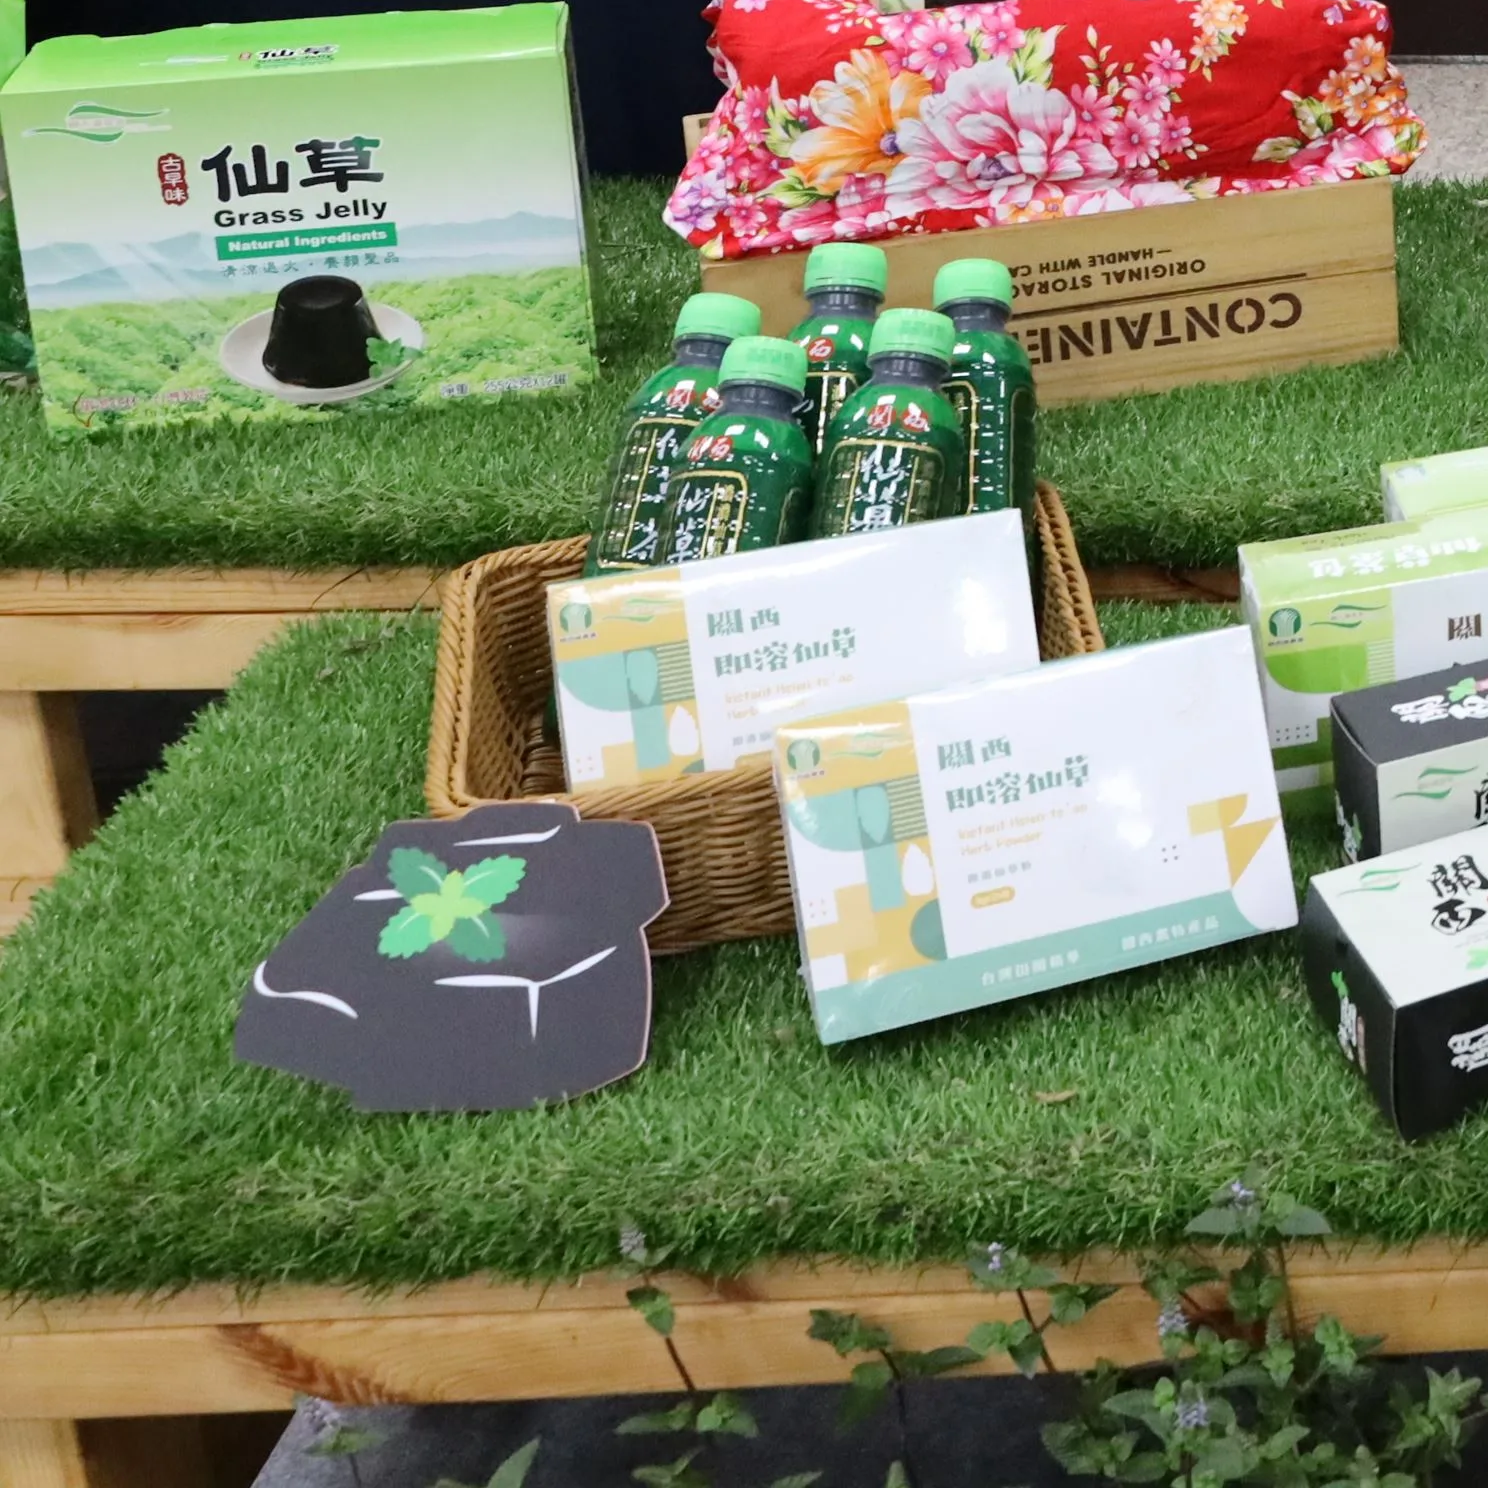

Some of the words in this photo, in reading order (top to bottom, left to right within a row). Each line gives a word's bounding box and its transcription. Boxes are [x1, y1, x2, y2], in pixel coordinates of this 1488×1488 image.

[161, 156, 186, 202] 古早味
[201, 136, 384, 202] 仙草
[214, 207, 304, 227] Grass
[315, 199, 388, 220] Jelly
[228, 237, 290, 253] Natural
[295, 229, 388, 247] Ingredients
[1087, 248, 1154, 267] HANDLE
[1038, 258, 1081, 275] WITH
[1101, 258, 1206, 284] ORIGINAL
[1010, 291, 1303, 364] CONTAINE
[707, 604, 781, 638] 關西
[713, 626, 857, 678] 即溶仙草
[937, 734, 1012, 772] 關西
[945, 754, 1090, 812] 即溶仙草
